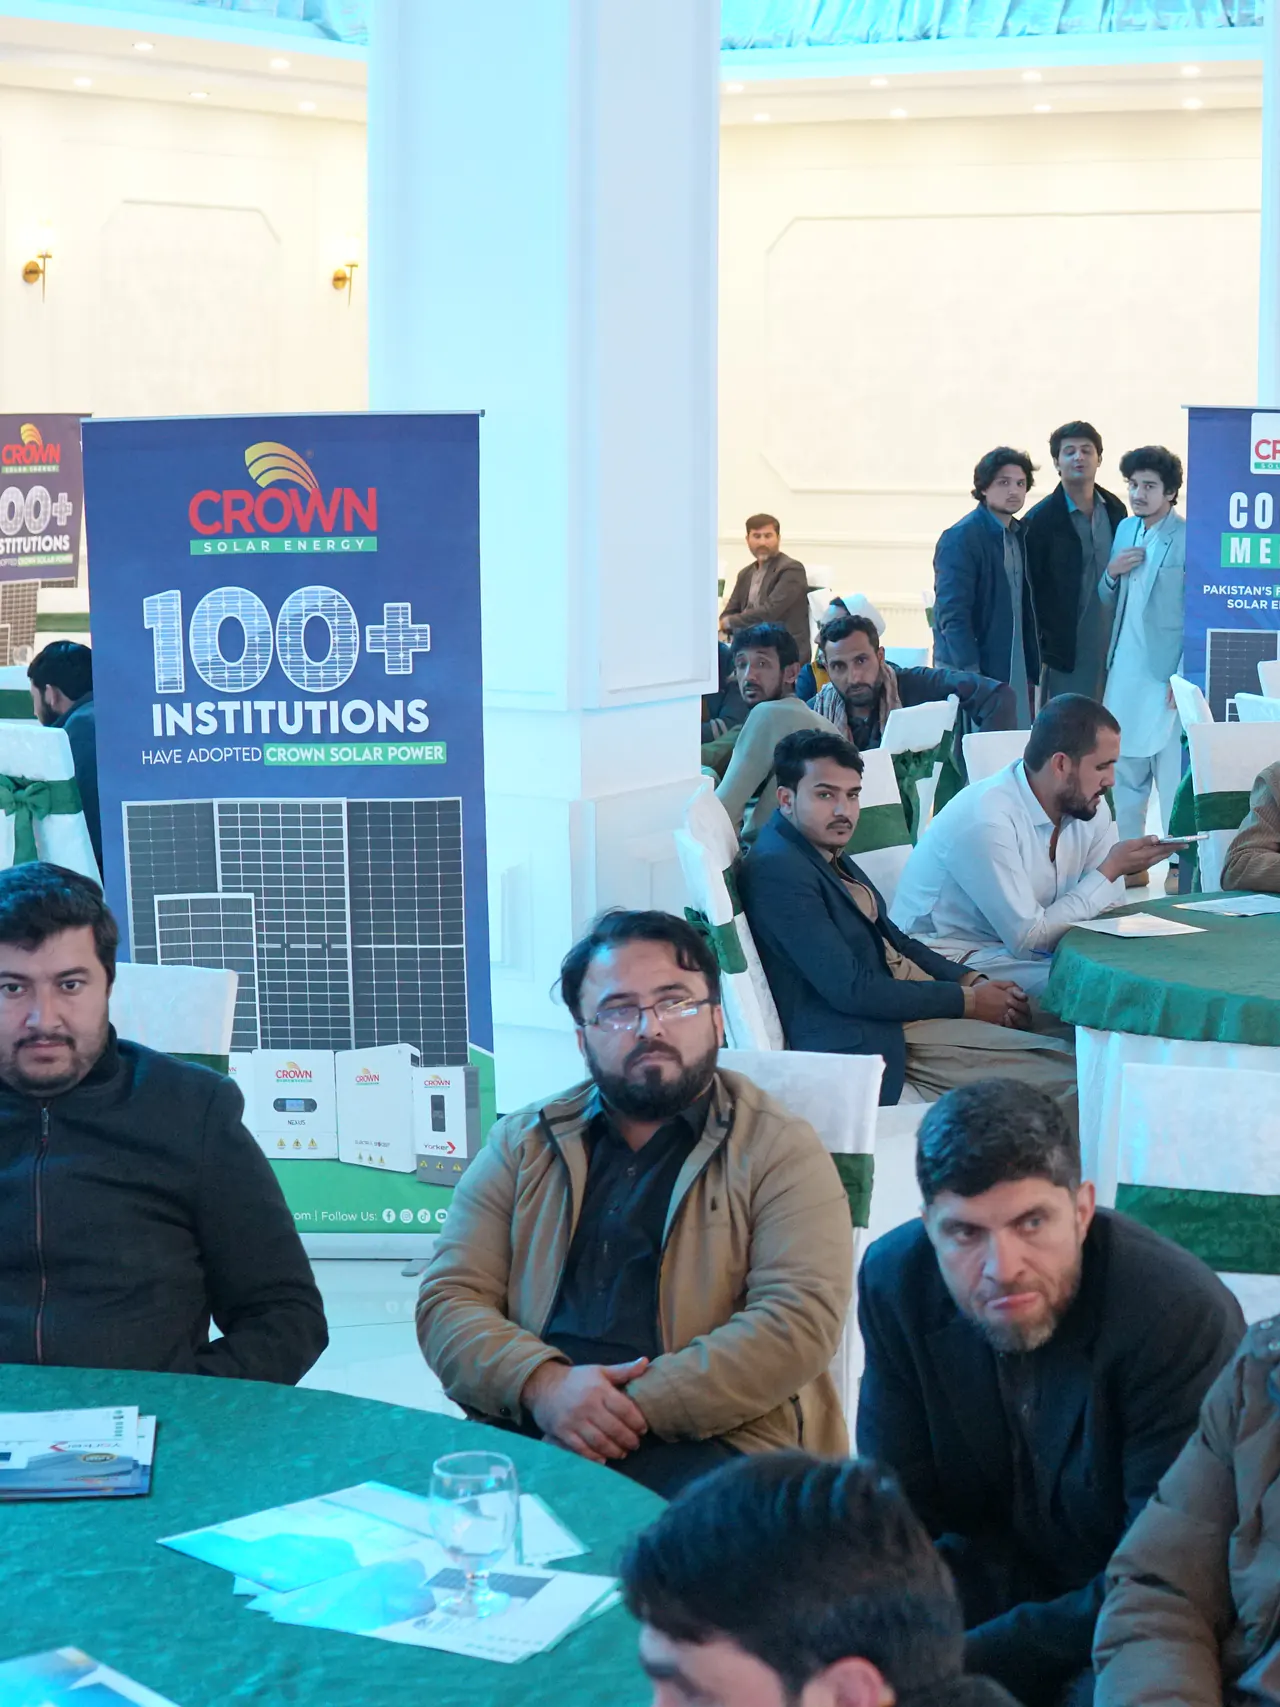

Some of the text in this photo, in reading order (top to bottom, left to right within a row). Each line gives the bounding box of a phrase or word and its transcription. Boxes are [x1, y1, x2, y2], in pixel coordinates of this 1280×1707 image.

[2, 443, 61, 465] CROWN
[0, 485, 73, 536] 00+
[188, 487, 377, 535] CROWN
[0, 534, 70, 555] STITUTIONS
[203, 539, 365, 553] SOLAR ENERGY
[1203, 584, 1272, 596] PAKISTAN'S
[1227, 599, 1268, 609] SOLAR
[143, 585, 430, 694] 100+
[152, 699, 430, 736] INSTITUTIONS
[142, 745, 444, 765] HAVE ADOPTED CROWN SOLAR POWER
[275, 1070, 312, 1079] CROWN
[354, 1074, 380, 1083] CROWN
[321, 1211, 357, 1222] Follow
[361, 1211, 378, 1221] Us:
